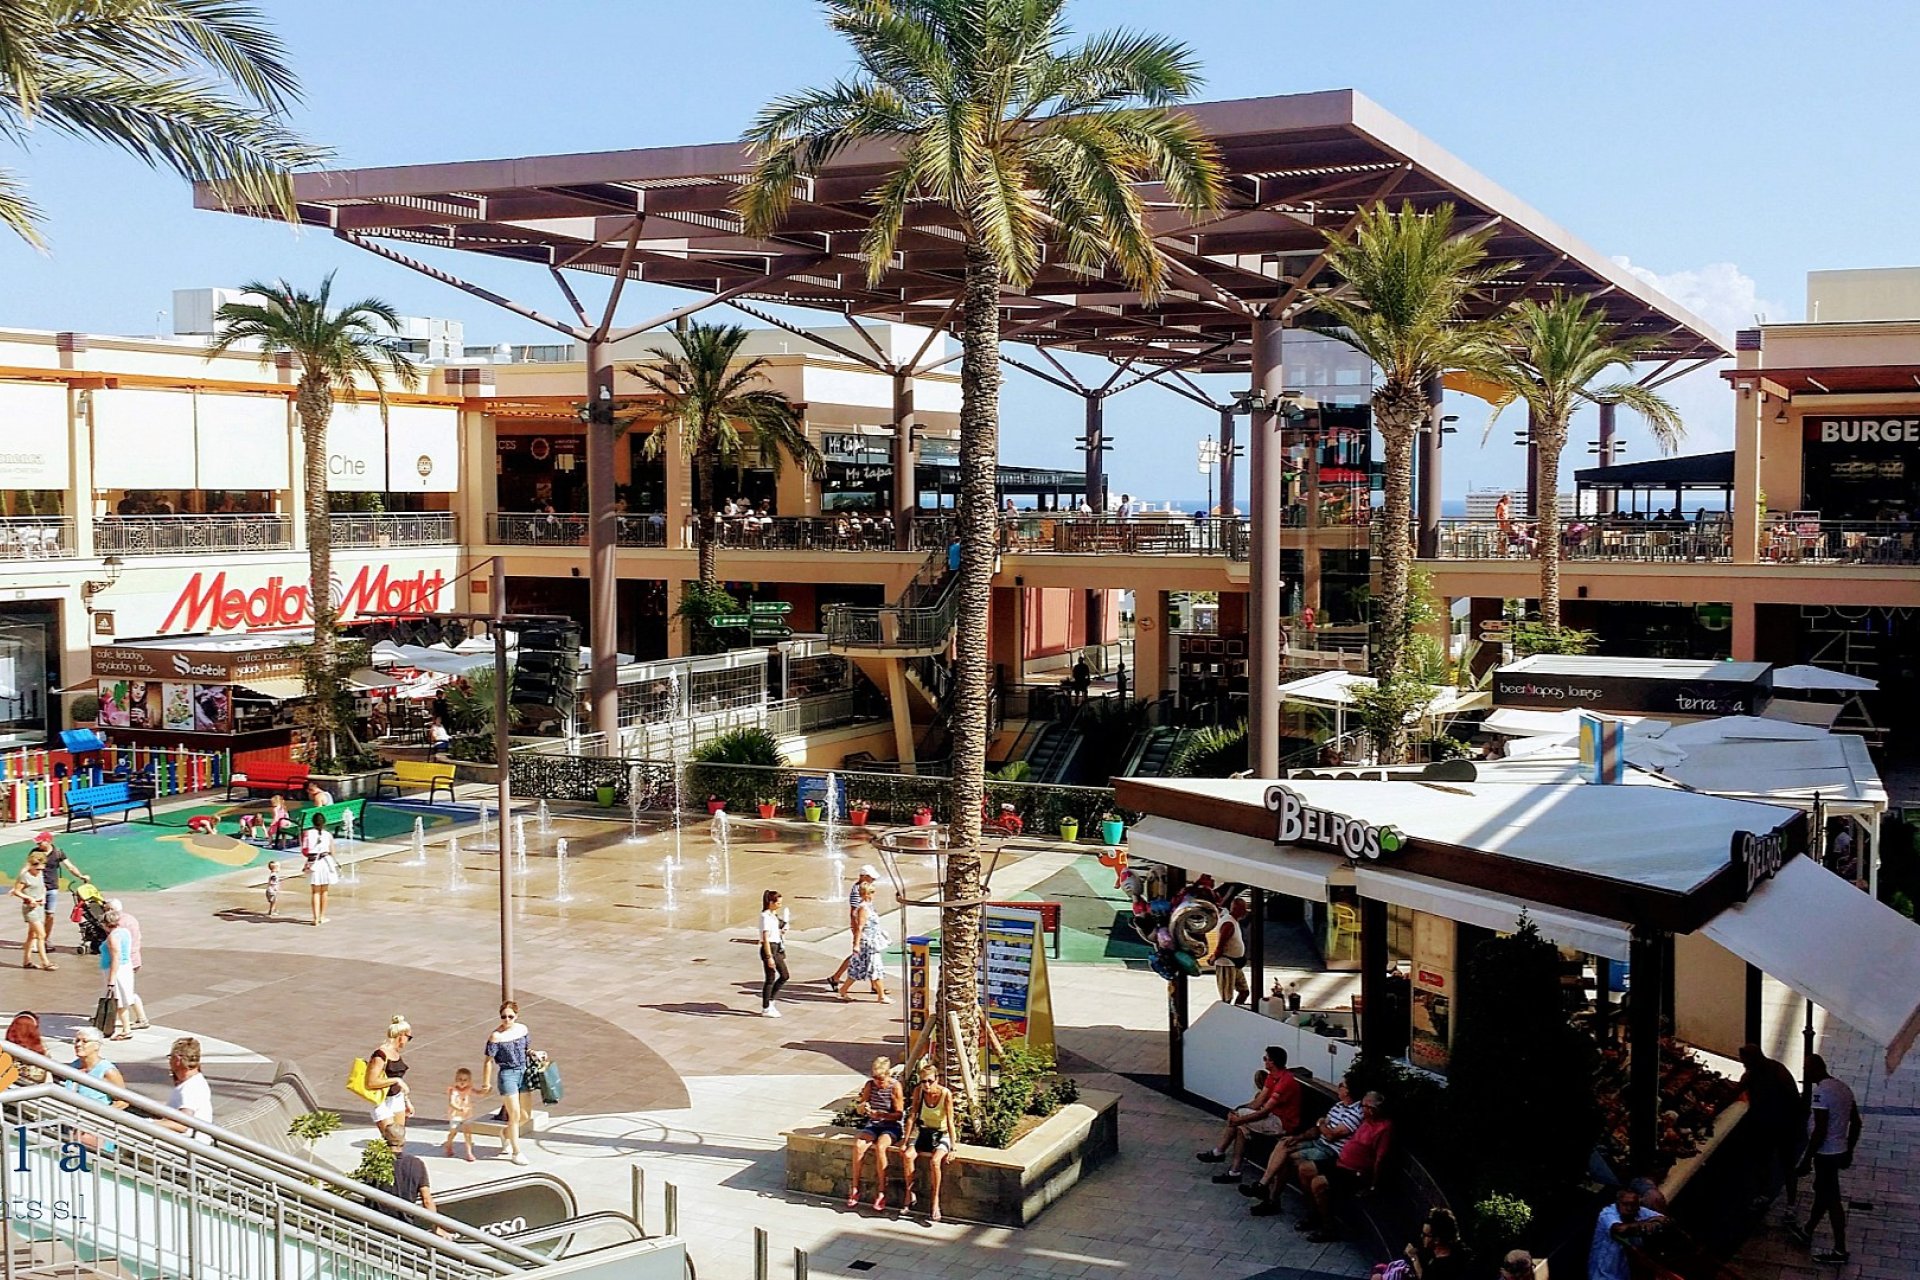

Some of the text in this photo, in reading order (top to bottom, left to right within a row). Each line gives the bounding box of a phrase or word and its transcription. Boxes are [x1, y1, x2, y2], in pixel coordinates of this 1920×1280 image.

[1822, 420, 1919, 442] BURGE
[328, 454, 366, 475] Che
[862, 465, 893, 482] tapa
[156, 564, 446, 634] Media Markt
[1264, 784, 1381, 859] BELROS
